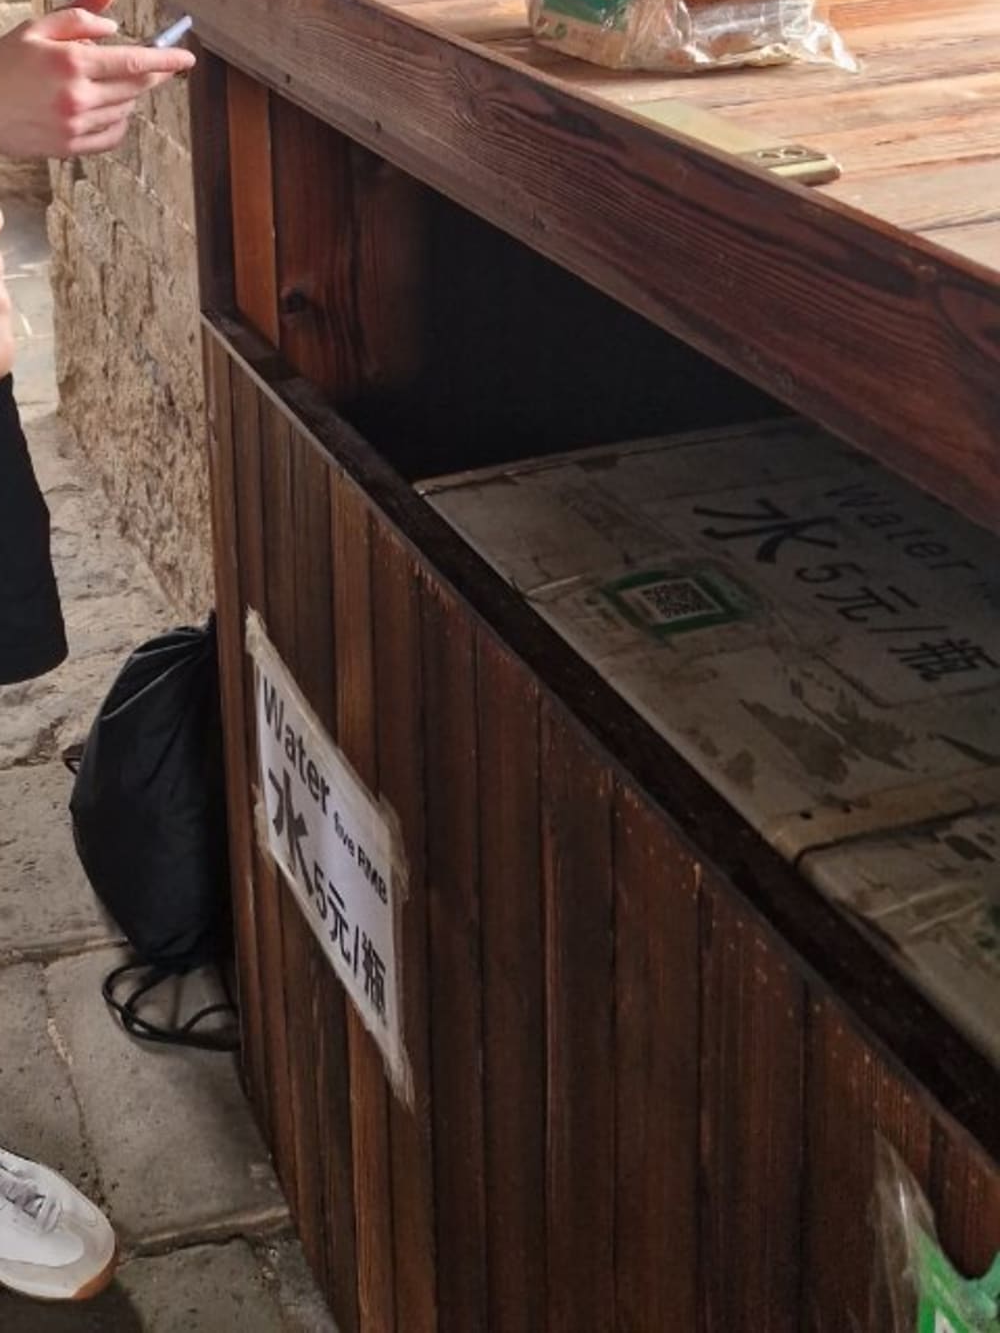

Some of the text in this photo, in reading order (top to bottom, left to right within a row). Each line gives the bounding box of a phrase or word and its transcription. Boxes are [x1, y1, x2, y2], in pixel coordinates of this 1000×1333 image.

[263, 676, 330, 816] Water
[357, 846, 388, 905] RMB
[269, 765, 388, 1028] 水5元/瓶
